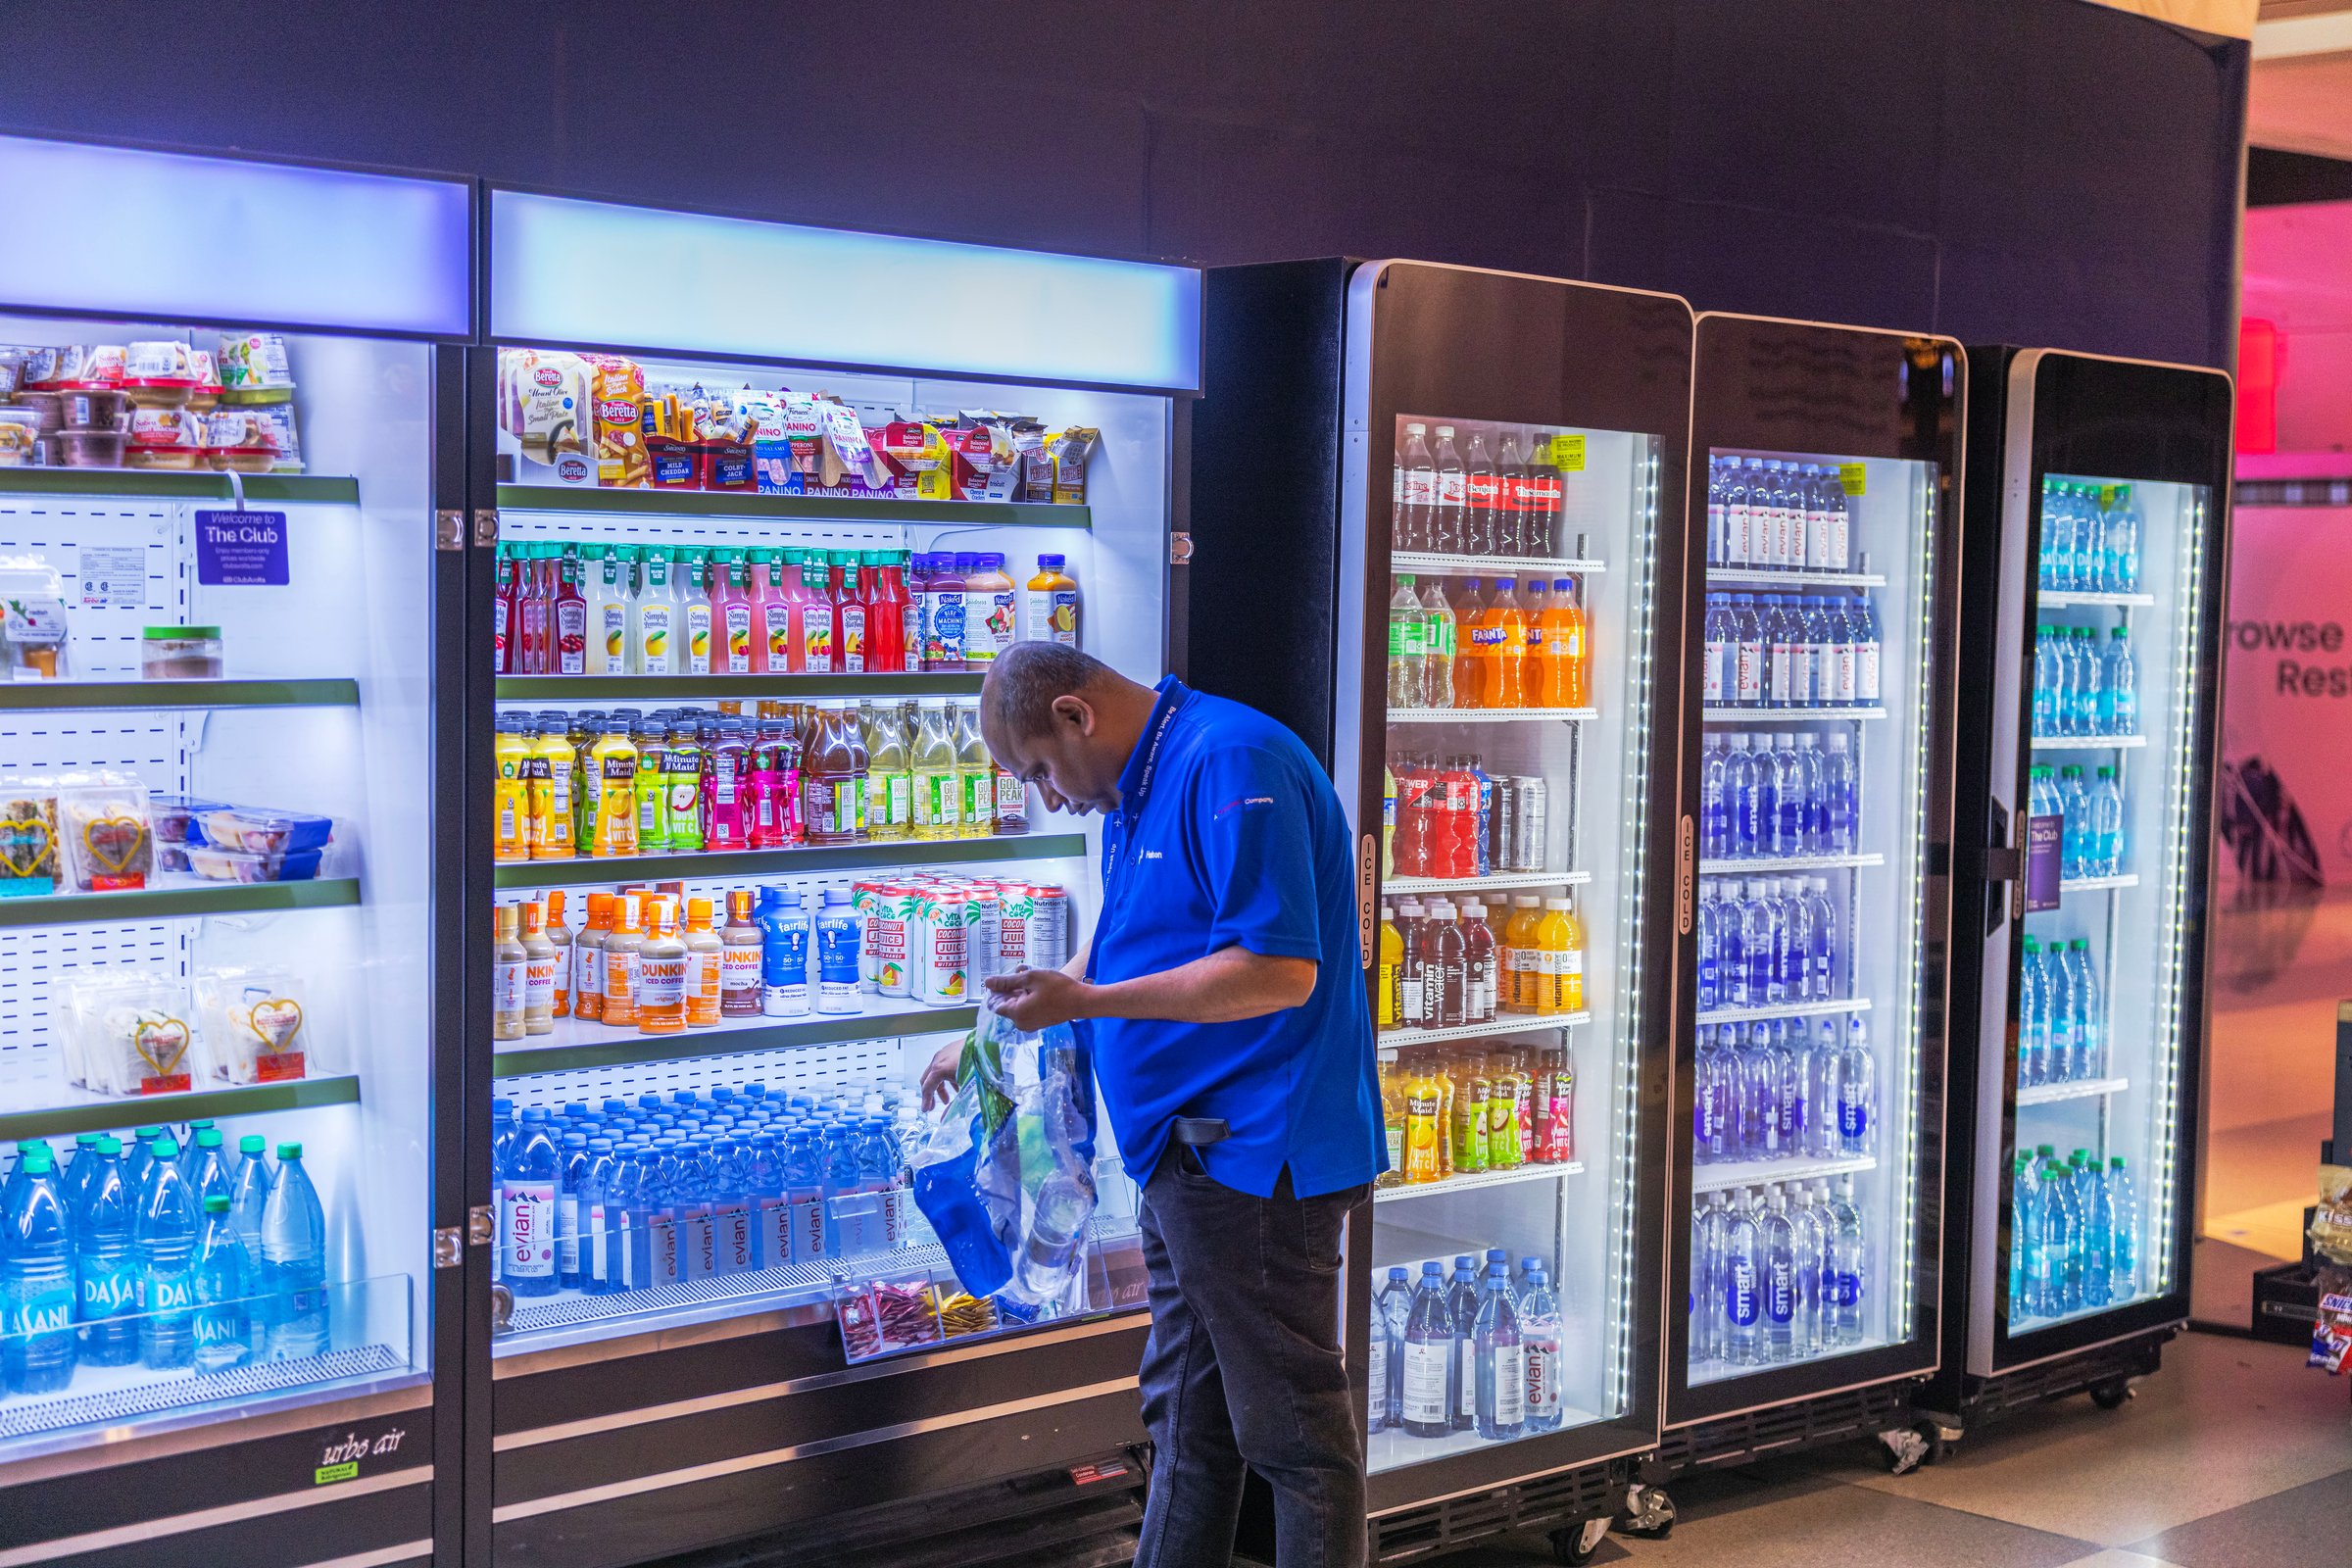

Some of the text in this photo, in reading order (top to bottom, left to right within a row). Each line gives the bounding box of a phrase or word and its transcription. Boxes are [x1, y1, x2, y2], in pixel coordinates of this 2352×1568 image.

[535, 370, 562, 382] Beretta
[604, 373, 628, 384] Italian
[601, 404, 637, 418] Beretta
[561, 465, 586, 476] Beretta
[759, 486, 801, 495] PANINO
[808, 487, 850, 497] PANINO
[853, 489, 893, 498] PANINO
[212, 513, 275, 524] Welcome to
[205, 526, 278, 544] The Club
[644, 612, 667, 623] Simply
[2229, 620, 2344, 653] rowse
[1740, 652, 1749, 690] evian
[1842, 656, 1851, 690] evian
[2278, 660, 2352, 698] Res
[1167, 706, 1177, 714] Be
[1155, 731, 1163, 741] Be
[607, 760, 634, 769] Minute
[1142, 765, 1152, 787] Speak
[1000, 790, 1023, 801] PEAK
[1138, 787, 1147, 797] Up
[673, 823, 687, 833] VIT
[2032, 830, 2058, 841] The Club
[1110, 844, 1117, 854] Up
[1362, 902, 1371, 961] COLD
[723, 952, 762, 963] UNKIN'
[940, 943, 965, 952] JUICE
[1424, 963, 1435, 1020] vitamin
[1434, 963, 1445, 1003] water
[1409, 1099, 1436, 1108] Minute
[1703, 1088, 1712, 1137] smart
[1782, 1083, 1792, 1131] smart
[1844, 1082, 1856, 1131] smart
[884, 1196, 896, 1242] evian
[2318, 1209, 2352, 1225] KISS
[513, 1205, 530, 1262] evian
[734, 1217, 746, 1266] evian
[777, 1212, 789, 1259] evian
[811, 1206, 822, 1254] evian
[666, 1231, 676, 1277] evian
[699, 1224, 712, 1271] evian
[85, 1274, 134, 1310] DASA
[1735, 1261, 1750, 1319] smart
[1774, 1262, 1788, 1315] smart
[2324, 1295, 2352, 1311] SNICK
[12, 1303, 69, 1343] ASANI
[194, 1314, 236, 1346] SANI
[1526, 1356, 1542, 1404] evian
[372, 1428, 406, 1454] air
